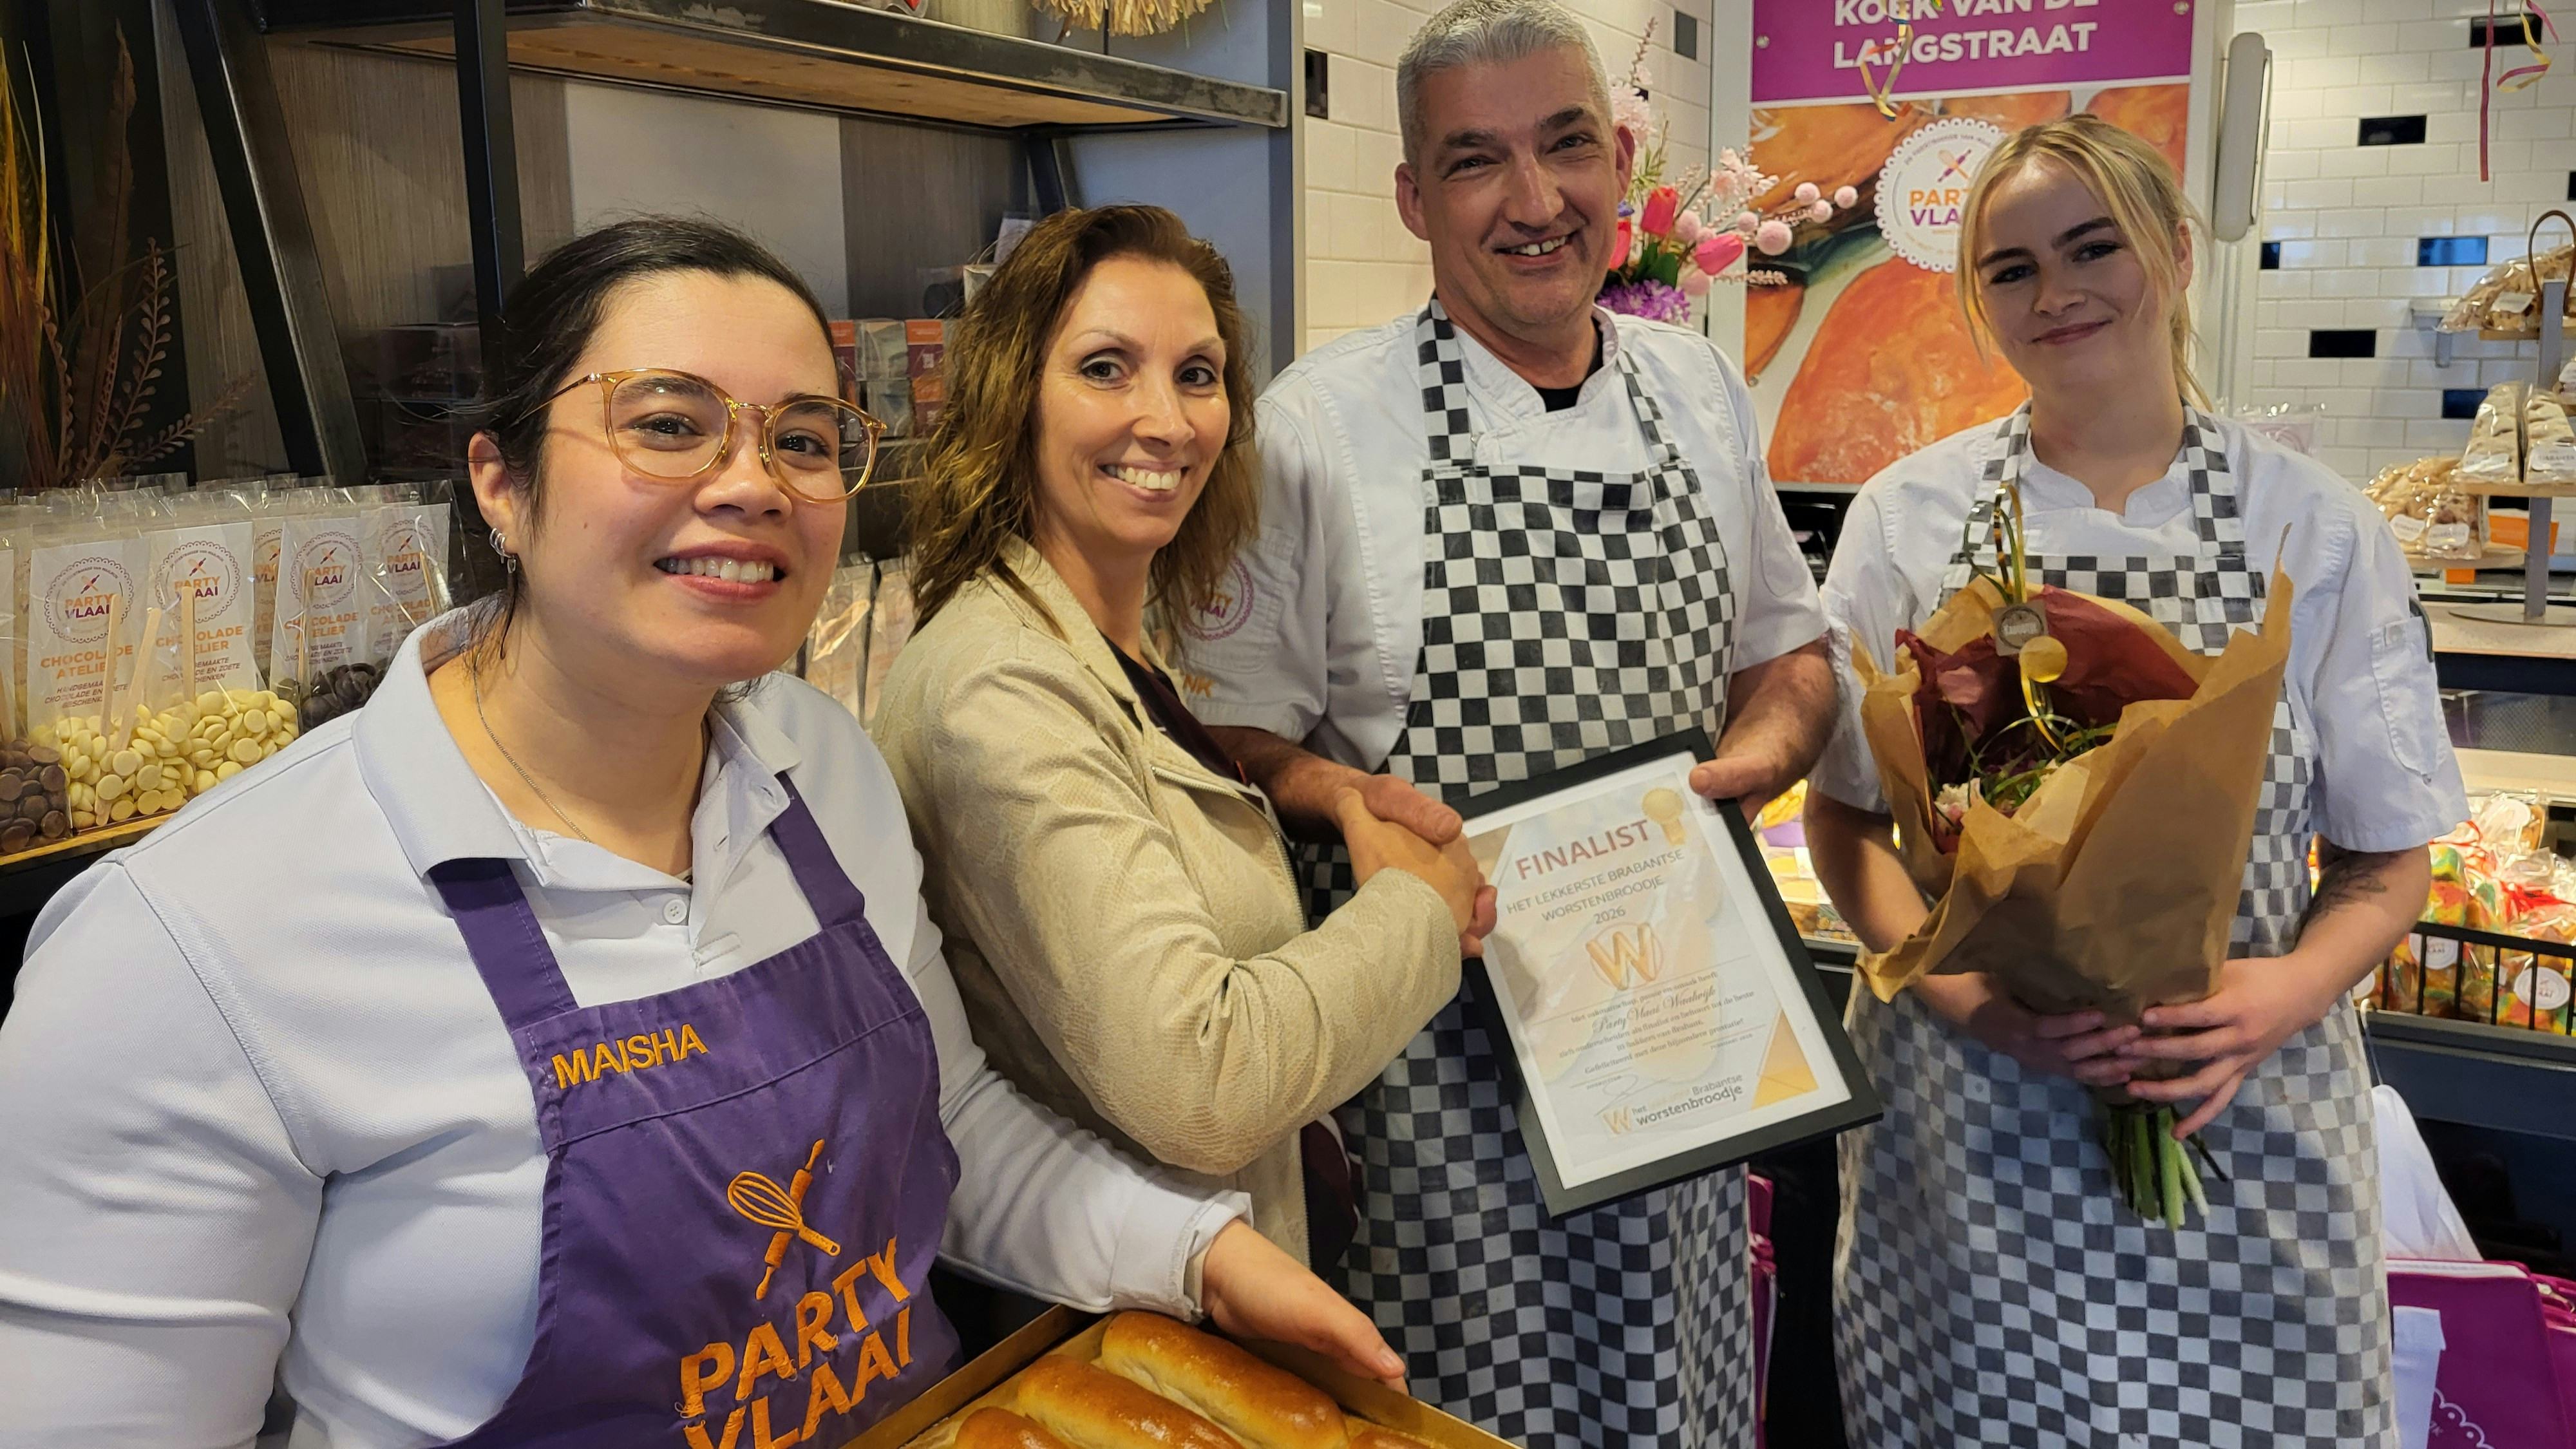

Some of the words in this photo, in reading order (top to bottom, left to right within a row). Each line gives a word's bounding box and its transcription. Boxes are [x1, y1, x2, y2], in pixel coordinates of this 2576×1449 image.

[1834, 0, 1939, 26] KOEK
[1833, 22, 2098, 69] LANGSTRAAT
[1909, 187, 1969, 207] PAR
[1909, 207, 1961, 226] VLA
[314, 565, 346, 575] ARTY
[387, 562, 421, 574] VLAAI
[175, 576, 221, 589] PARTY
[314, 574, 343, 586] LAAI
[65, 592, 115, 610] PARTY
[65, 604, 110, 620] VLAAI
[284, 612, 359, 630] CHCOLADE
[155, 625, 243, 648] CHOLADE
[194, 640, 229, 655] ELIER
[57, 661, 117, 680] ATELIE
[218, 663, 241, 672] ZOETE
[92, 688, 104, 697] EN
[1515, 819, 1649, 880] FINALIST
[1506, 897, 1532, 914] HET
[1535, 873, 1607, 905] LEKKERSTE
[1608, 849, 1685, 882] BRABANTSE
[1541, 875, 1665, 922] WORSTENBROODJE
[1594, 905, 1627, 925] 2026
[1586, 922, 1657, 991] W
[1591, 1014, 1627, 1034] Party
[551, 1023, 709, 1090] MAISHA
[1691, 1073, 1743, 1095] Brabantse
[1636, 1084, 1743, 1127] worstenbroodje
[679, 1233, 911, 1419] PARTY
[683, 1305, 913, 1449] VLAAI
